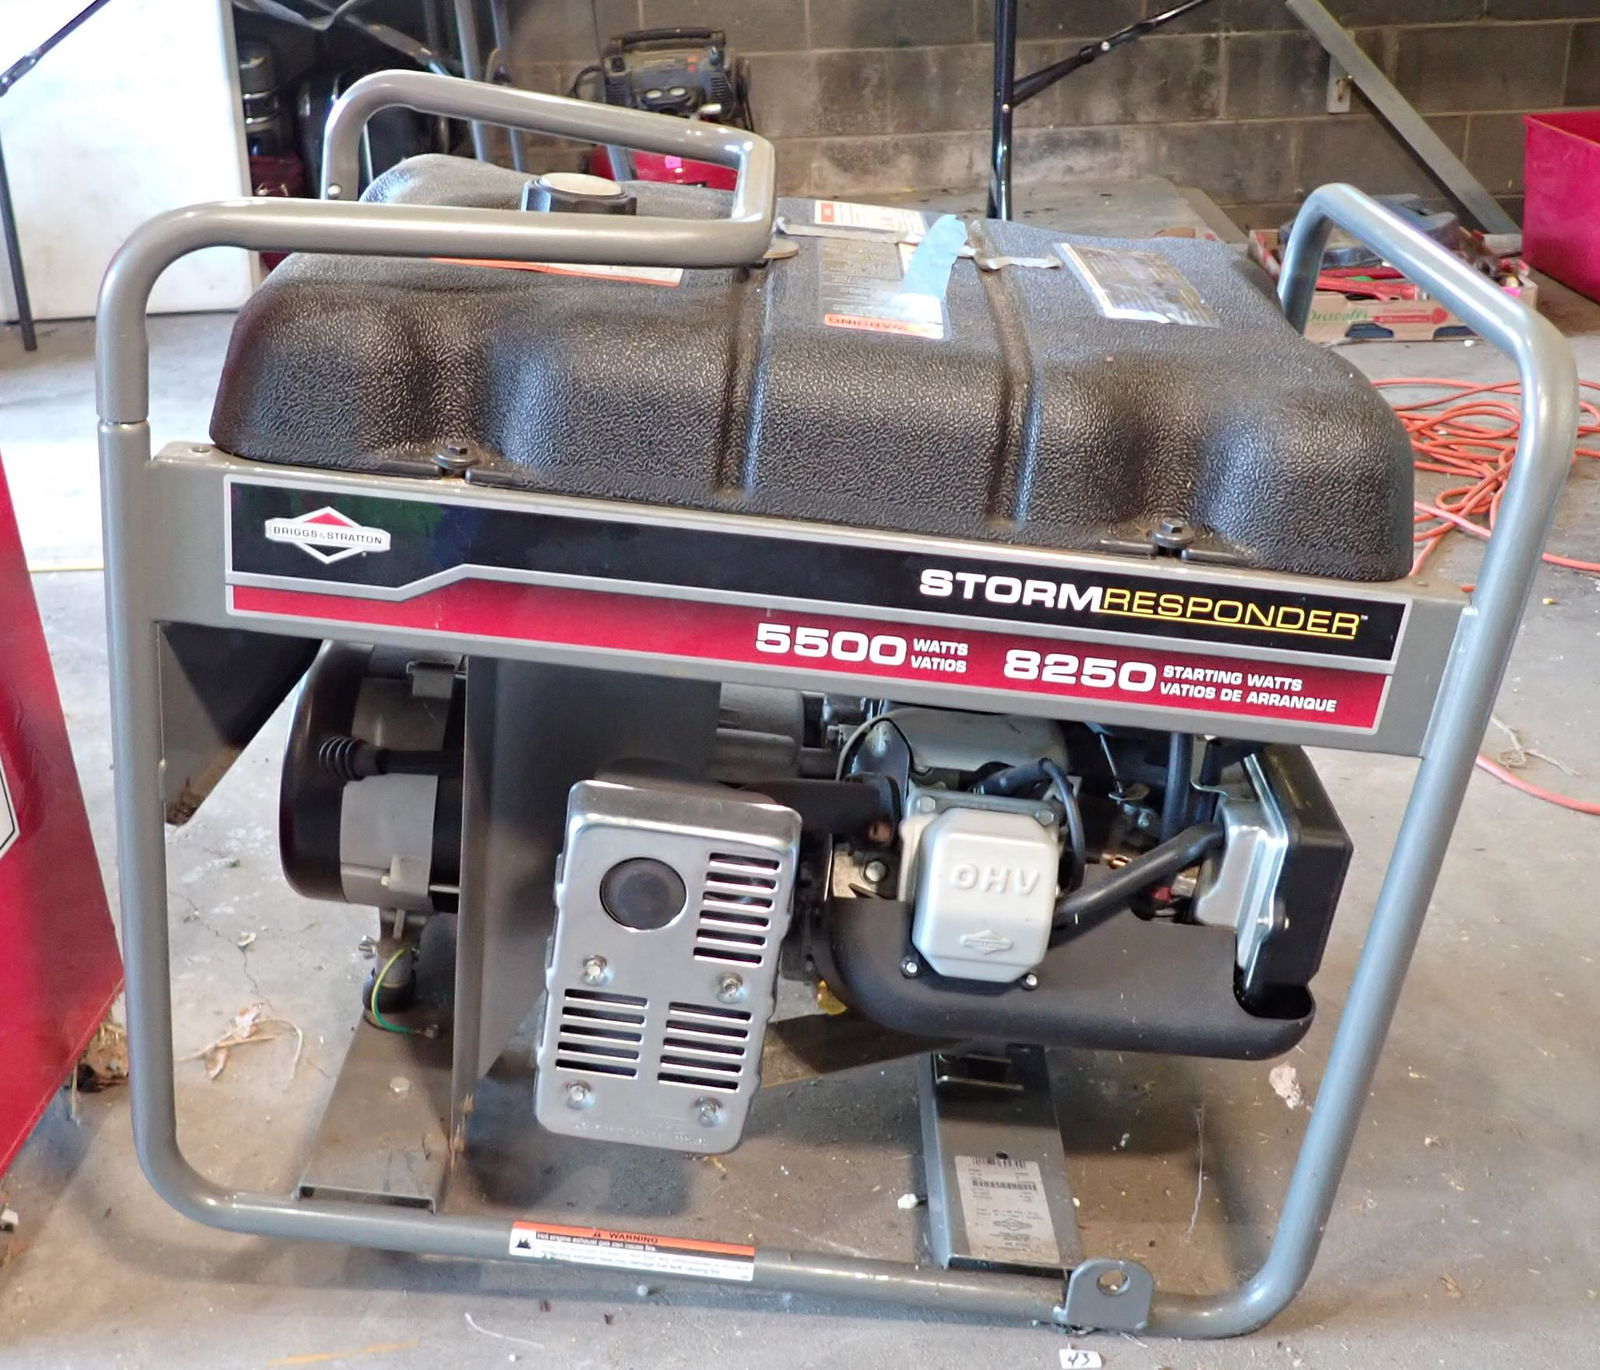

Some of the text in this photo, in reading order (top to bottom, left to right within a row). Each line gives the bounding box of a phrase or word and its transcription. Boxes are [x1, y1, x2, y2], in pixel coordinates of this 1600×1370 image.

[755, 622, 969, 667] 5500 WATTS
[910, 655, 967, 673] VATIOS
[1003, 649, 1303, 693] 8250 STARTING WATTS
[1160, 682, 1337, 713] VATIOS DE ARRANQUE
[952, 864, 1041, 896] OHV
